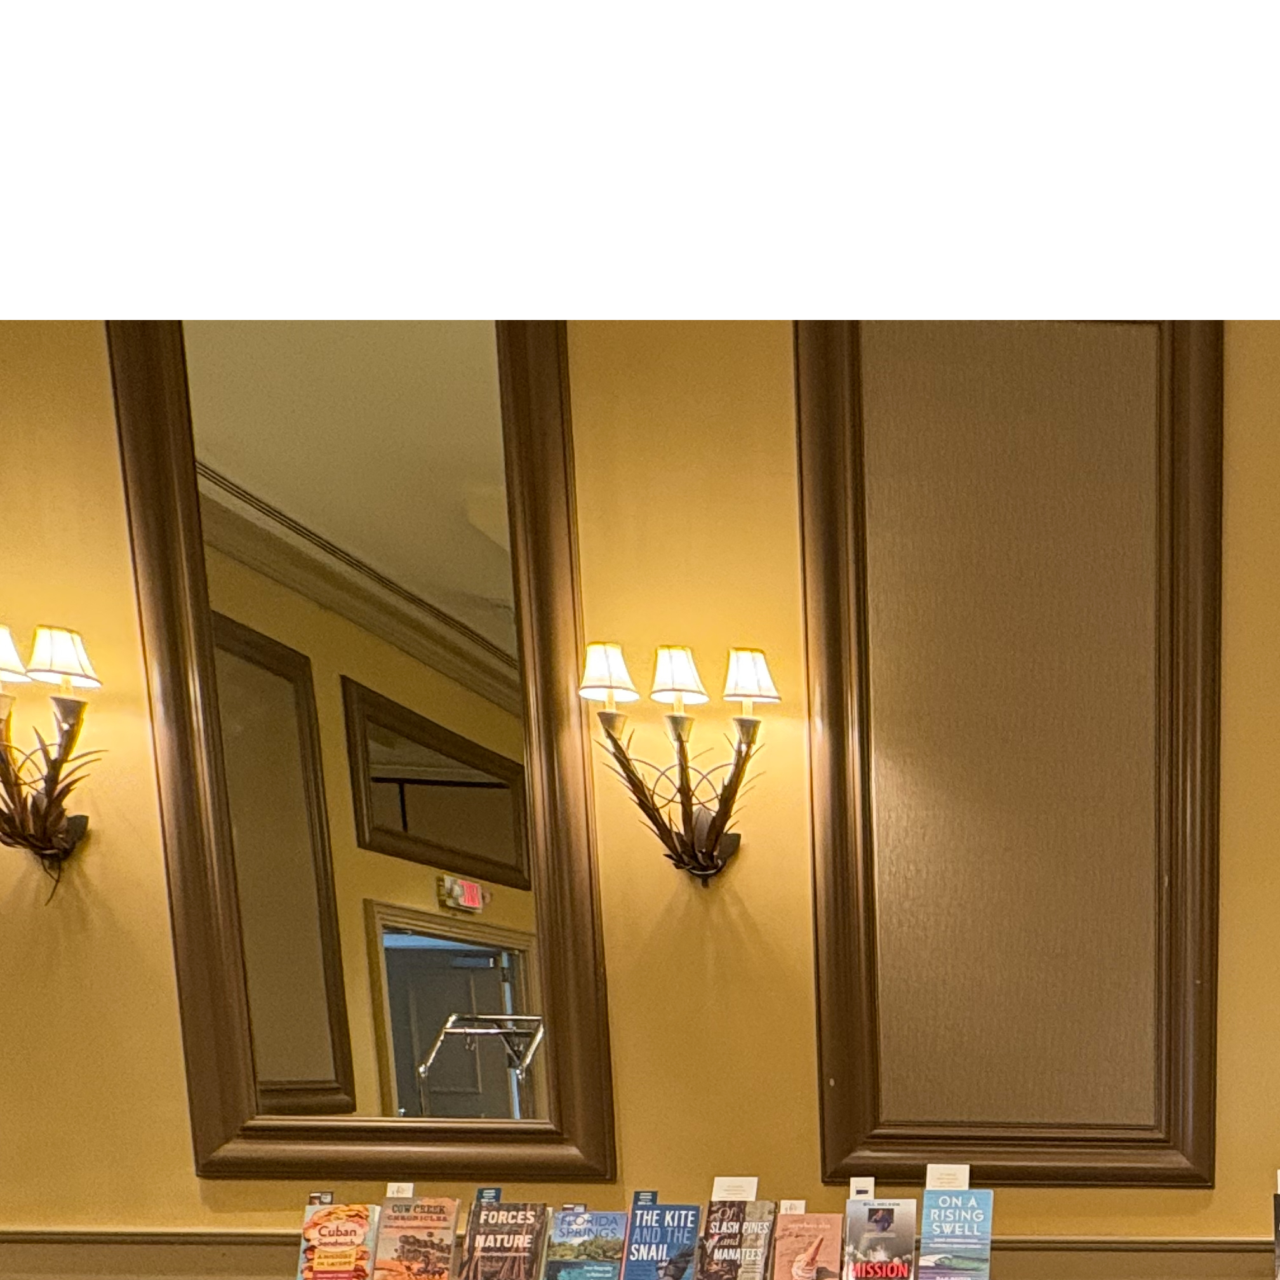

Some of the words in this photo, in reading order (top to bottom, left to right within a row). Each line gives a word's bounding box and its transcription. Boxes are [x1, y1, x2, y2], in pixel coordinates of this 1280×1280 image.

[939, 1196, 962, 1208] ON
[968, 1196, 977, 1207] A
[392, 1204, 411, 1213] COW
[413, 1204, 446, 1214] CREEK
[718, 1208, 736, 1222] Of
[479, 1211, 535, 1224] FORCES
[560, 1215, 618, 1227] FLORIDA
[635, 1210, 661, 1227] THE
[665, 1211, 696, 1227] KITE
[930, 1209, 984, 1222] RISING
[318, 1226, 357, 1237] Cuban
[558, 1228, 617, 1238] SPRINGS
[710, 1222, 739, 1234] SLASH
[742, 1222, 771, 1234] PINES
[932, 1223, 981, 1235] SWELL
[475, 1234, 533, 1248] NATURE
[632, 1228, 661, 1243] AND
[667, 1227, 692, 1244] THE
[720, 1235, 740, 1246] and
[318, 1238, 356, 1247] Sandwich
[630, 1244, 670, 1261] SNAIL
[714, 1248, 763, 1260] MANATEES
[852, 1262, 908, 1278] MISSION
